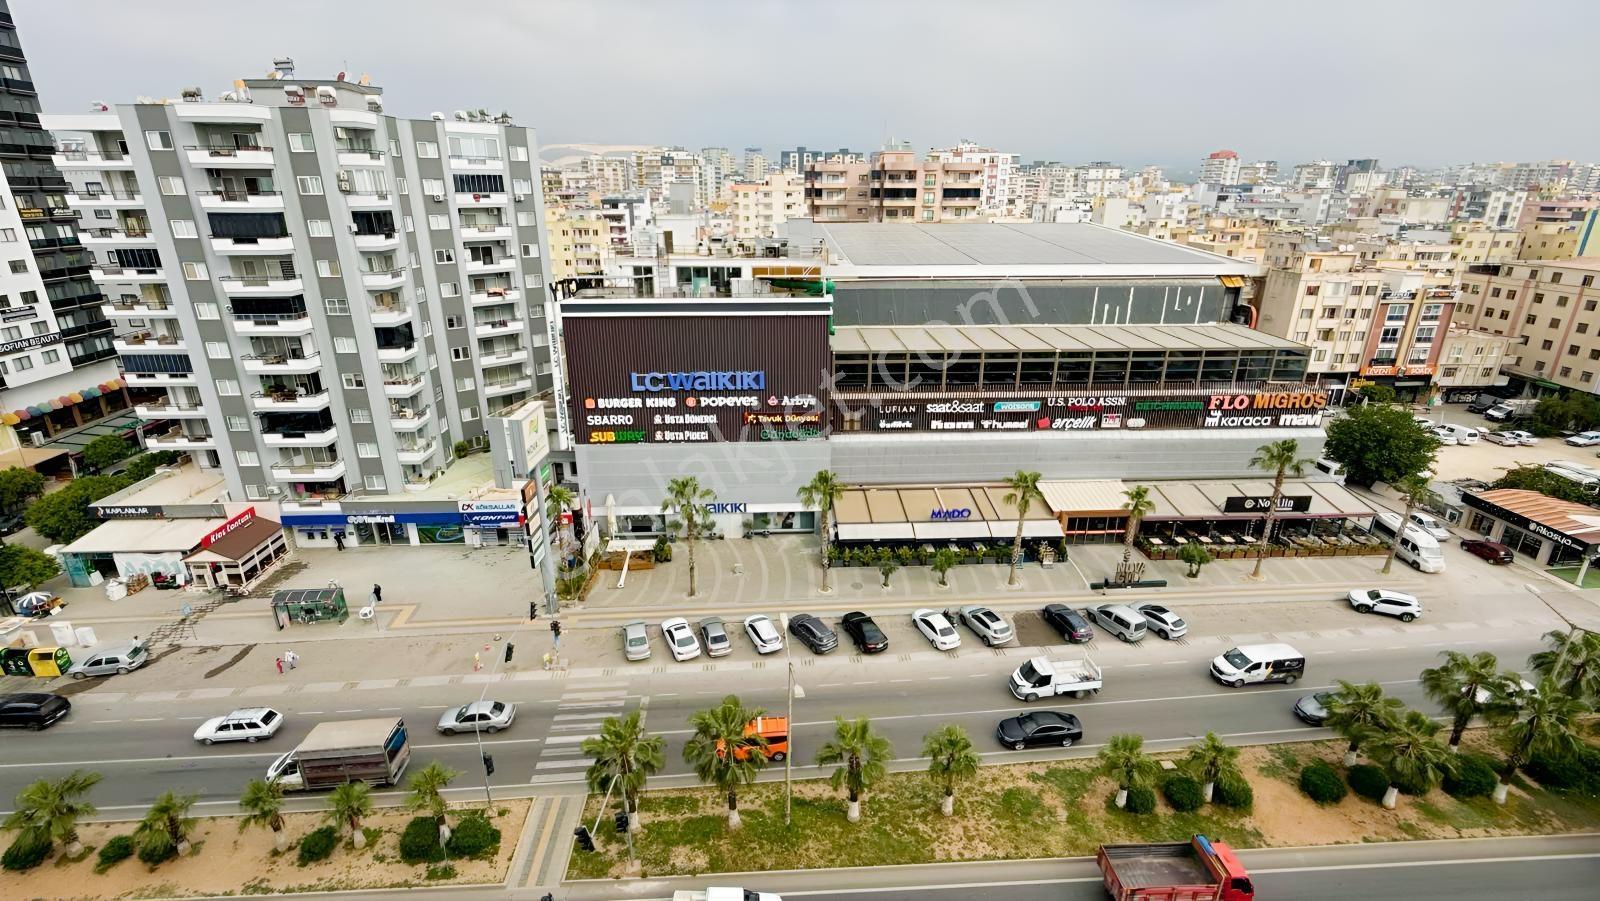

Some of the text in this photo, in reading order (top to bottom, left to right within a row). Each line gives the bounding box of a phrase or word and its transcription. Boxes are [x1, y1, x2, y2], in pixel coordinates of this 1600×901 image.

[30, 333, 60, 347] BEAUTY
[631, 372, 665, 392] LC
[597, 397, 676, 409] BURGER KING
[926, 399, 985, 413] saat&saat
[1047, 396, 1127, 407] U.S. POLO ASSN.
[1208, 395, 1250, 410] FLO
[1253, 392, 1328, 409] MIGROS
[879, 404, 916, 414] LUFIAN
[586, 414, 634, 426] SBARRO
[757, 414, 783, 423] Tavuk
[1052, 415, 1097, 431] arçelik
[1220, 415, 1272, 427] karaca
[1278, 409, 1325, 426] mavi
[992, 419, 1029, 429] hummel
[589, 431, 646, 443] SUBWAY
[930, 508, 972, 519] MADO
[1535, 525, 1572, 547] Akasya
